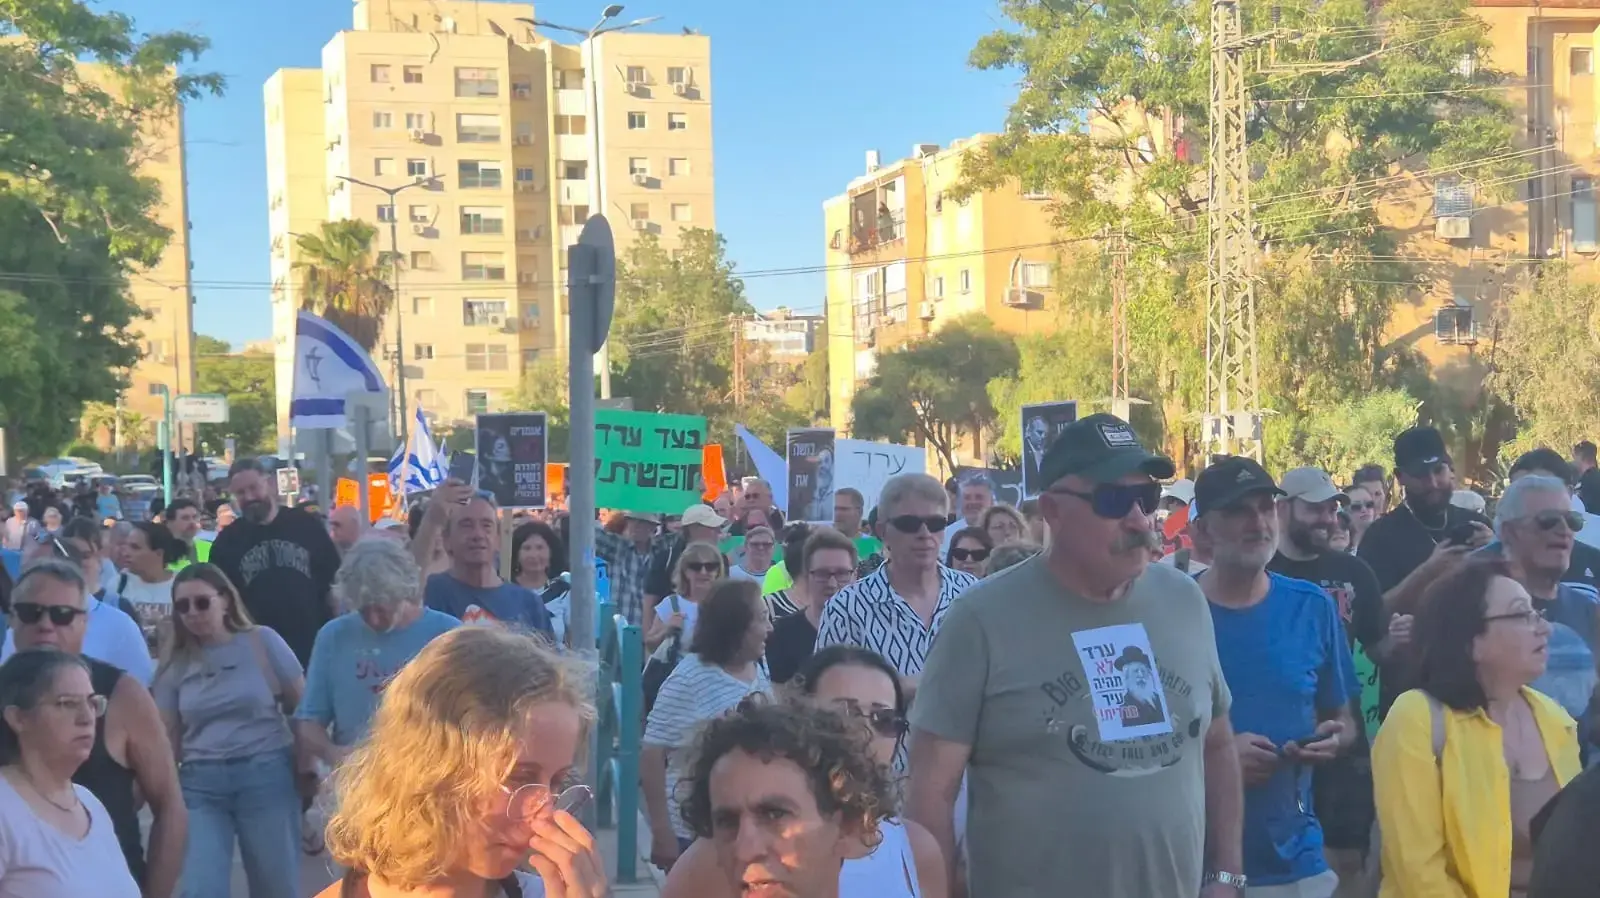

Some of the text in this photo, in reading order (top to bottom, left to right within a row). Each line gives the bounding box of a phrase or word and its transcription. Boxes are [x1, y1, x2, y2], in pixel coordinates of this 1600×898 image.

[595, 423, 703, 449] בצד ערד
[852, 451, 906, 475] ערד
[1082, 642, 1116, 659] ערד
[1095, 658, 1115, 675] לא
[1041, 672, 1082, 707] BIG
[1093, 676, 1123, 690] תהיה
[1102, 693, 1125, 706] עיר
